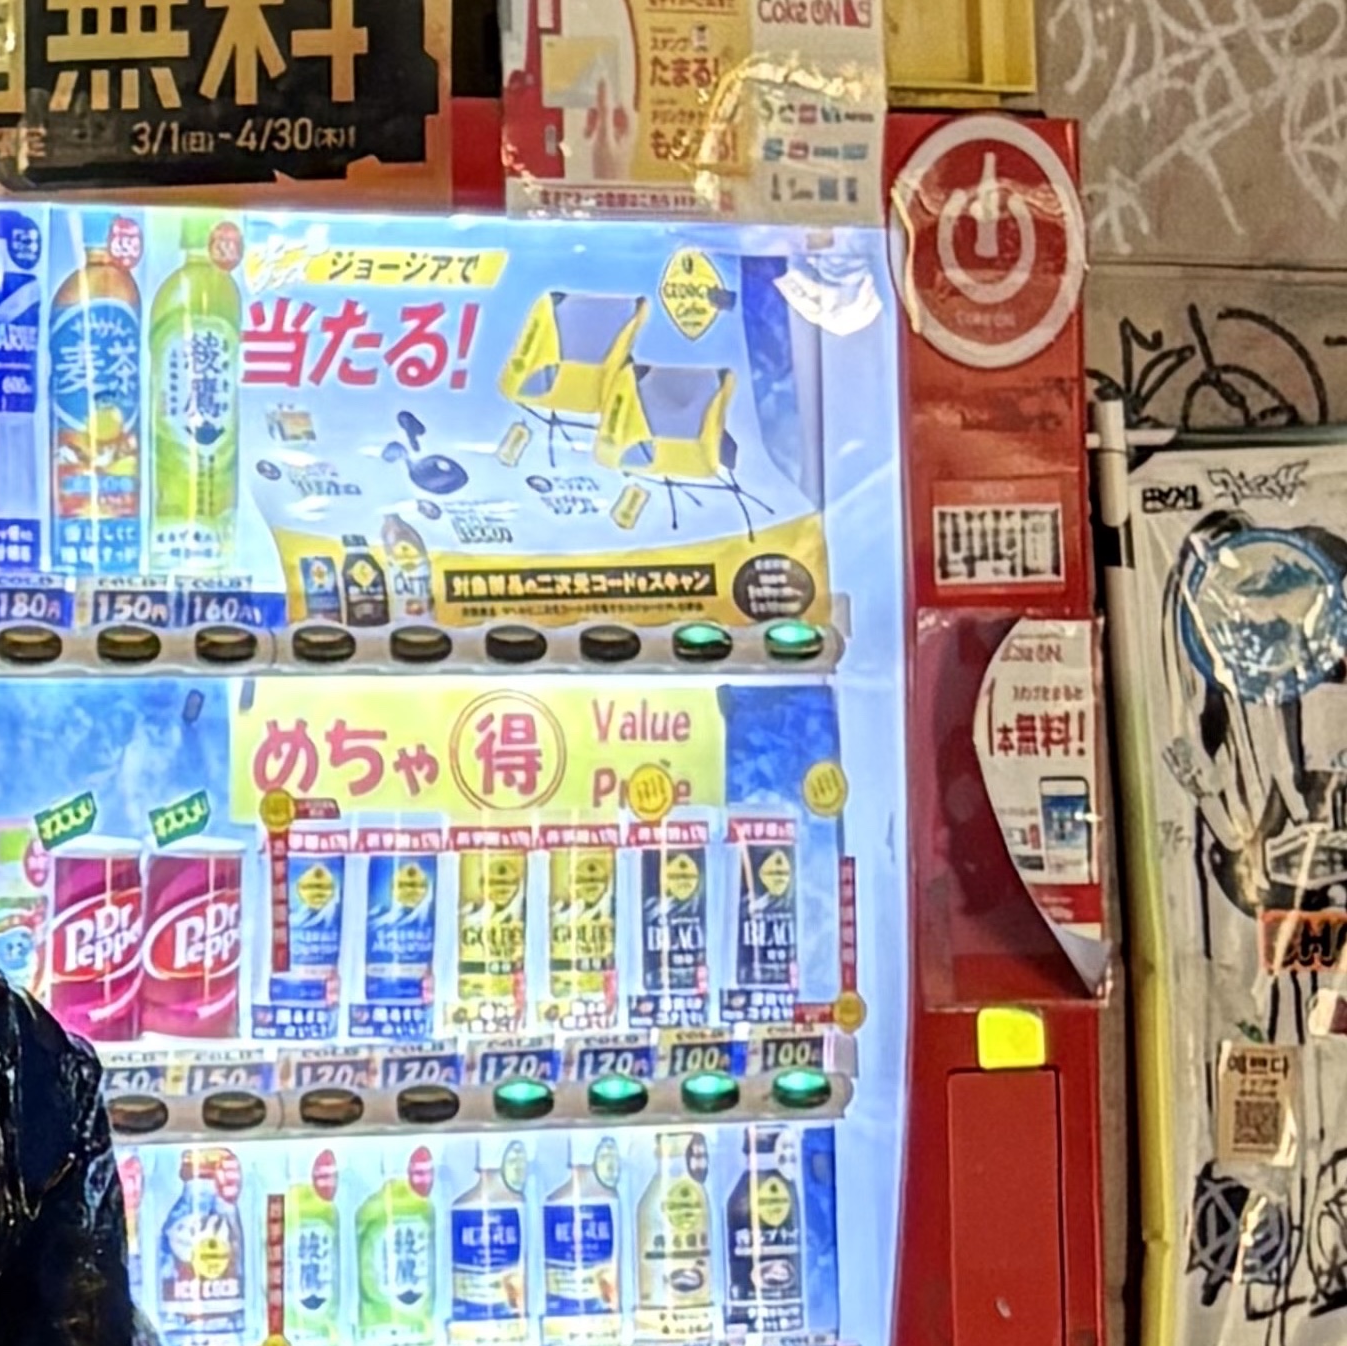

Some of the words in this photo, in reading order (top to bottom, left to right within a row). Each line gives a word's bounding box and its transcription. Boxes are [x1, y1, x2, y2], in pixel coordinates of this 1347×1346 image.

[651, 57, 720, 88] たまる!
[328, 250, 479, 284] ジョージアで
[241, 296, 482, 389] 当たる!
[56, 340, 139, 396] 麦茶
[592, 698, 691, 744] Value
[253, 719, 439, 798] めちゃ
[475, 712, 543, 798] 得
[592, 767, 692, 808] Pre
[93, 902, 134, 936] Dr
[173, 915, 240, 970] Pepp
[110, 1068, 164, 1091] 50円
